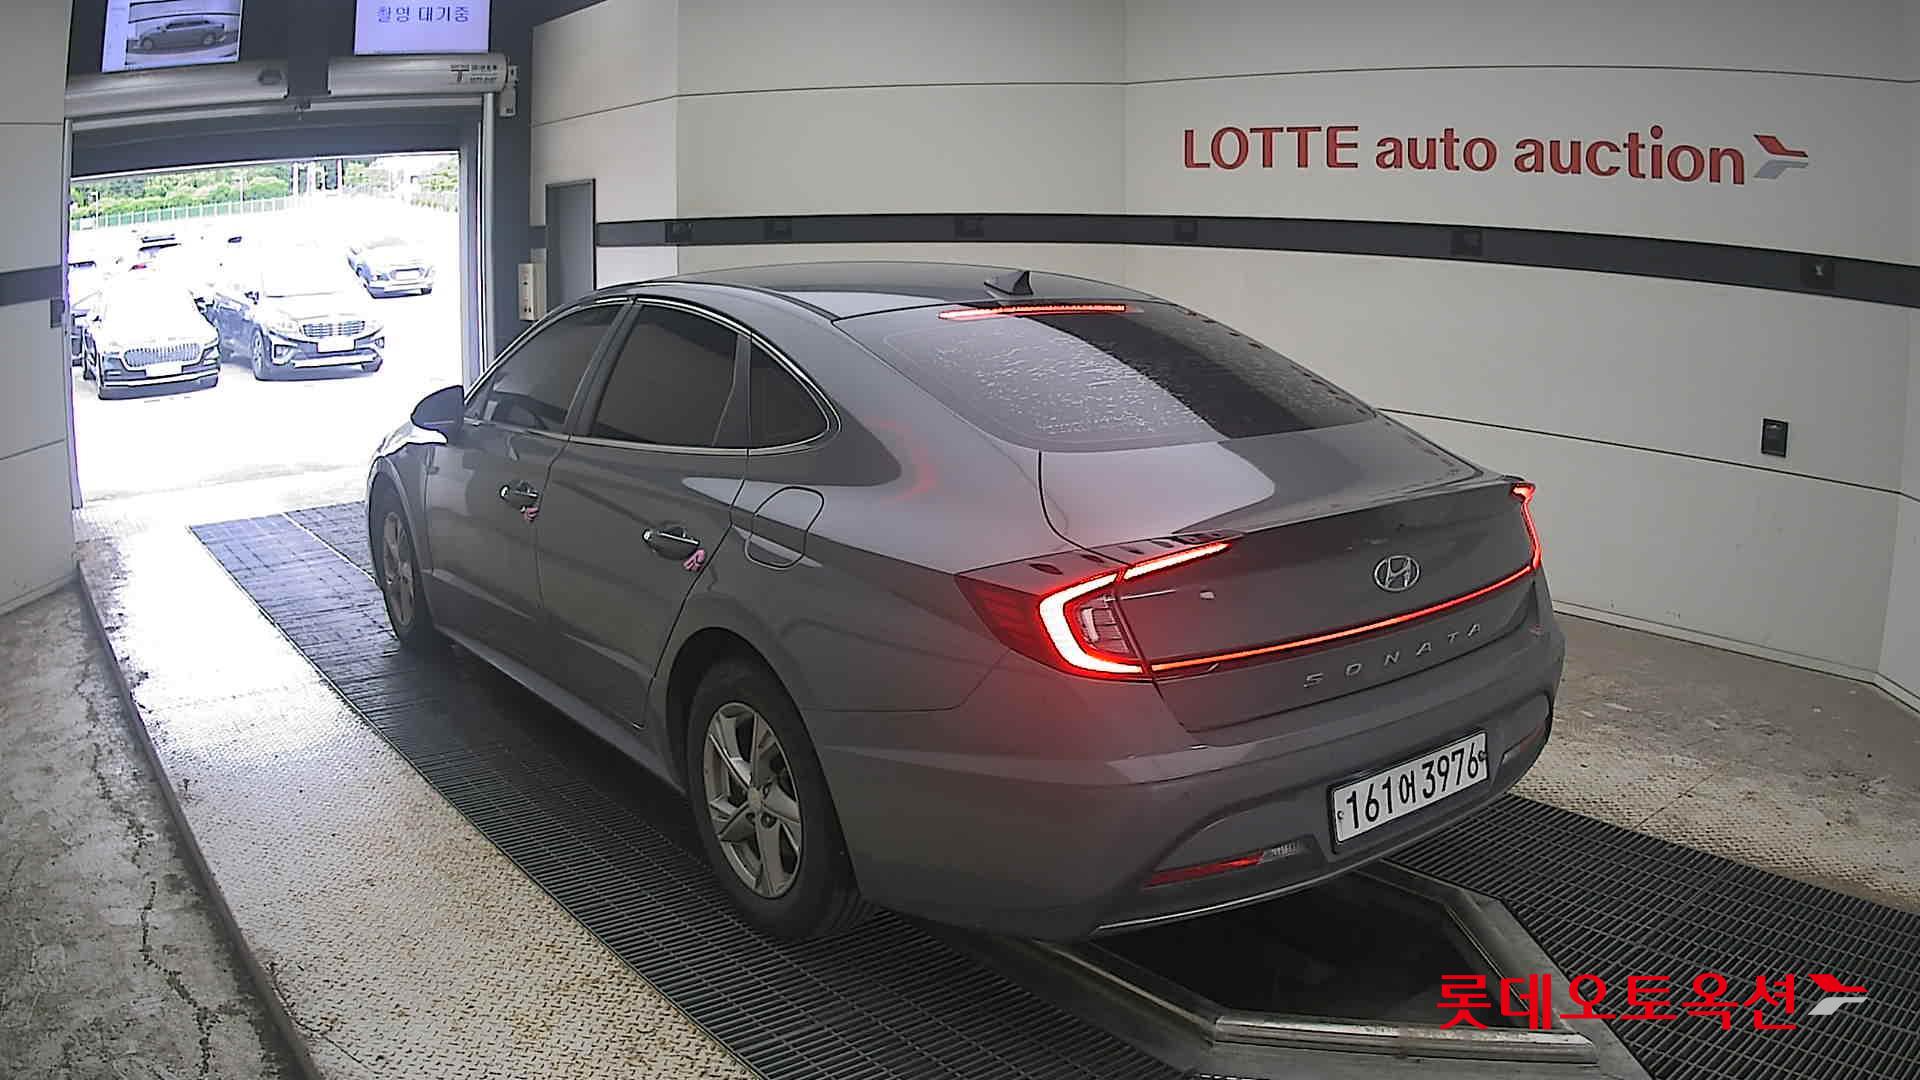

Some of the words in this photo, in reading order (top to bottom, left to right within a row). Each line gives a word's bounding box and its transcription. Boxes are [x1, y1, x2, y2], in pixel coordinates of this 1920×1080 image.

[418, 5, 469, 23] 대기중
[1183, 125, 1360, 171] LOTTE
[1375, 127, 1498, 172] auto
[1513, 124, 1746, 185] auction
[1303, 622, 1482, 689] SONATA
